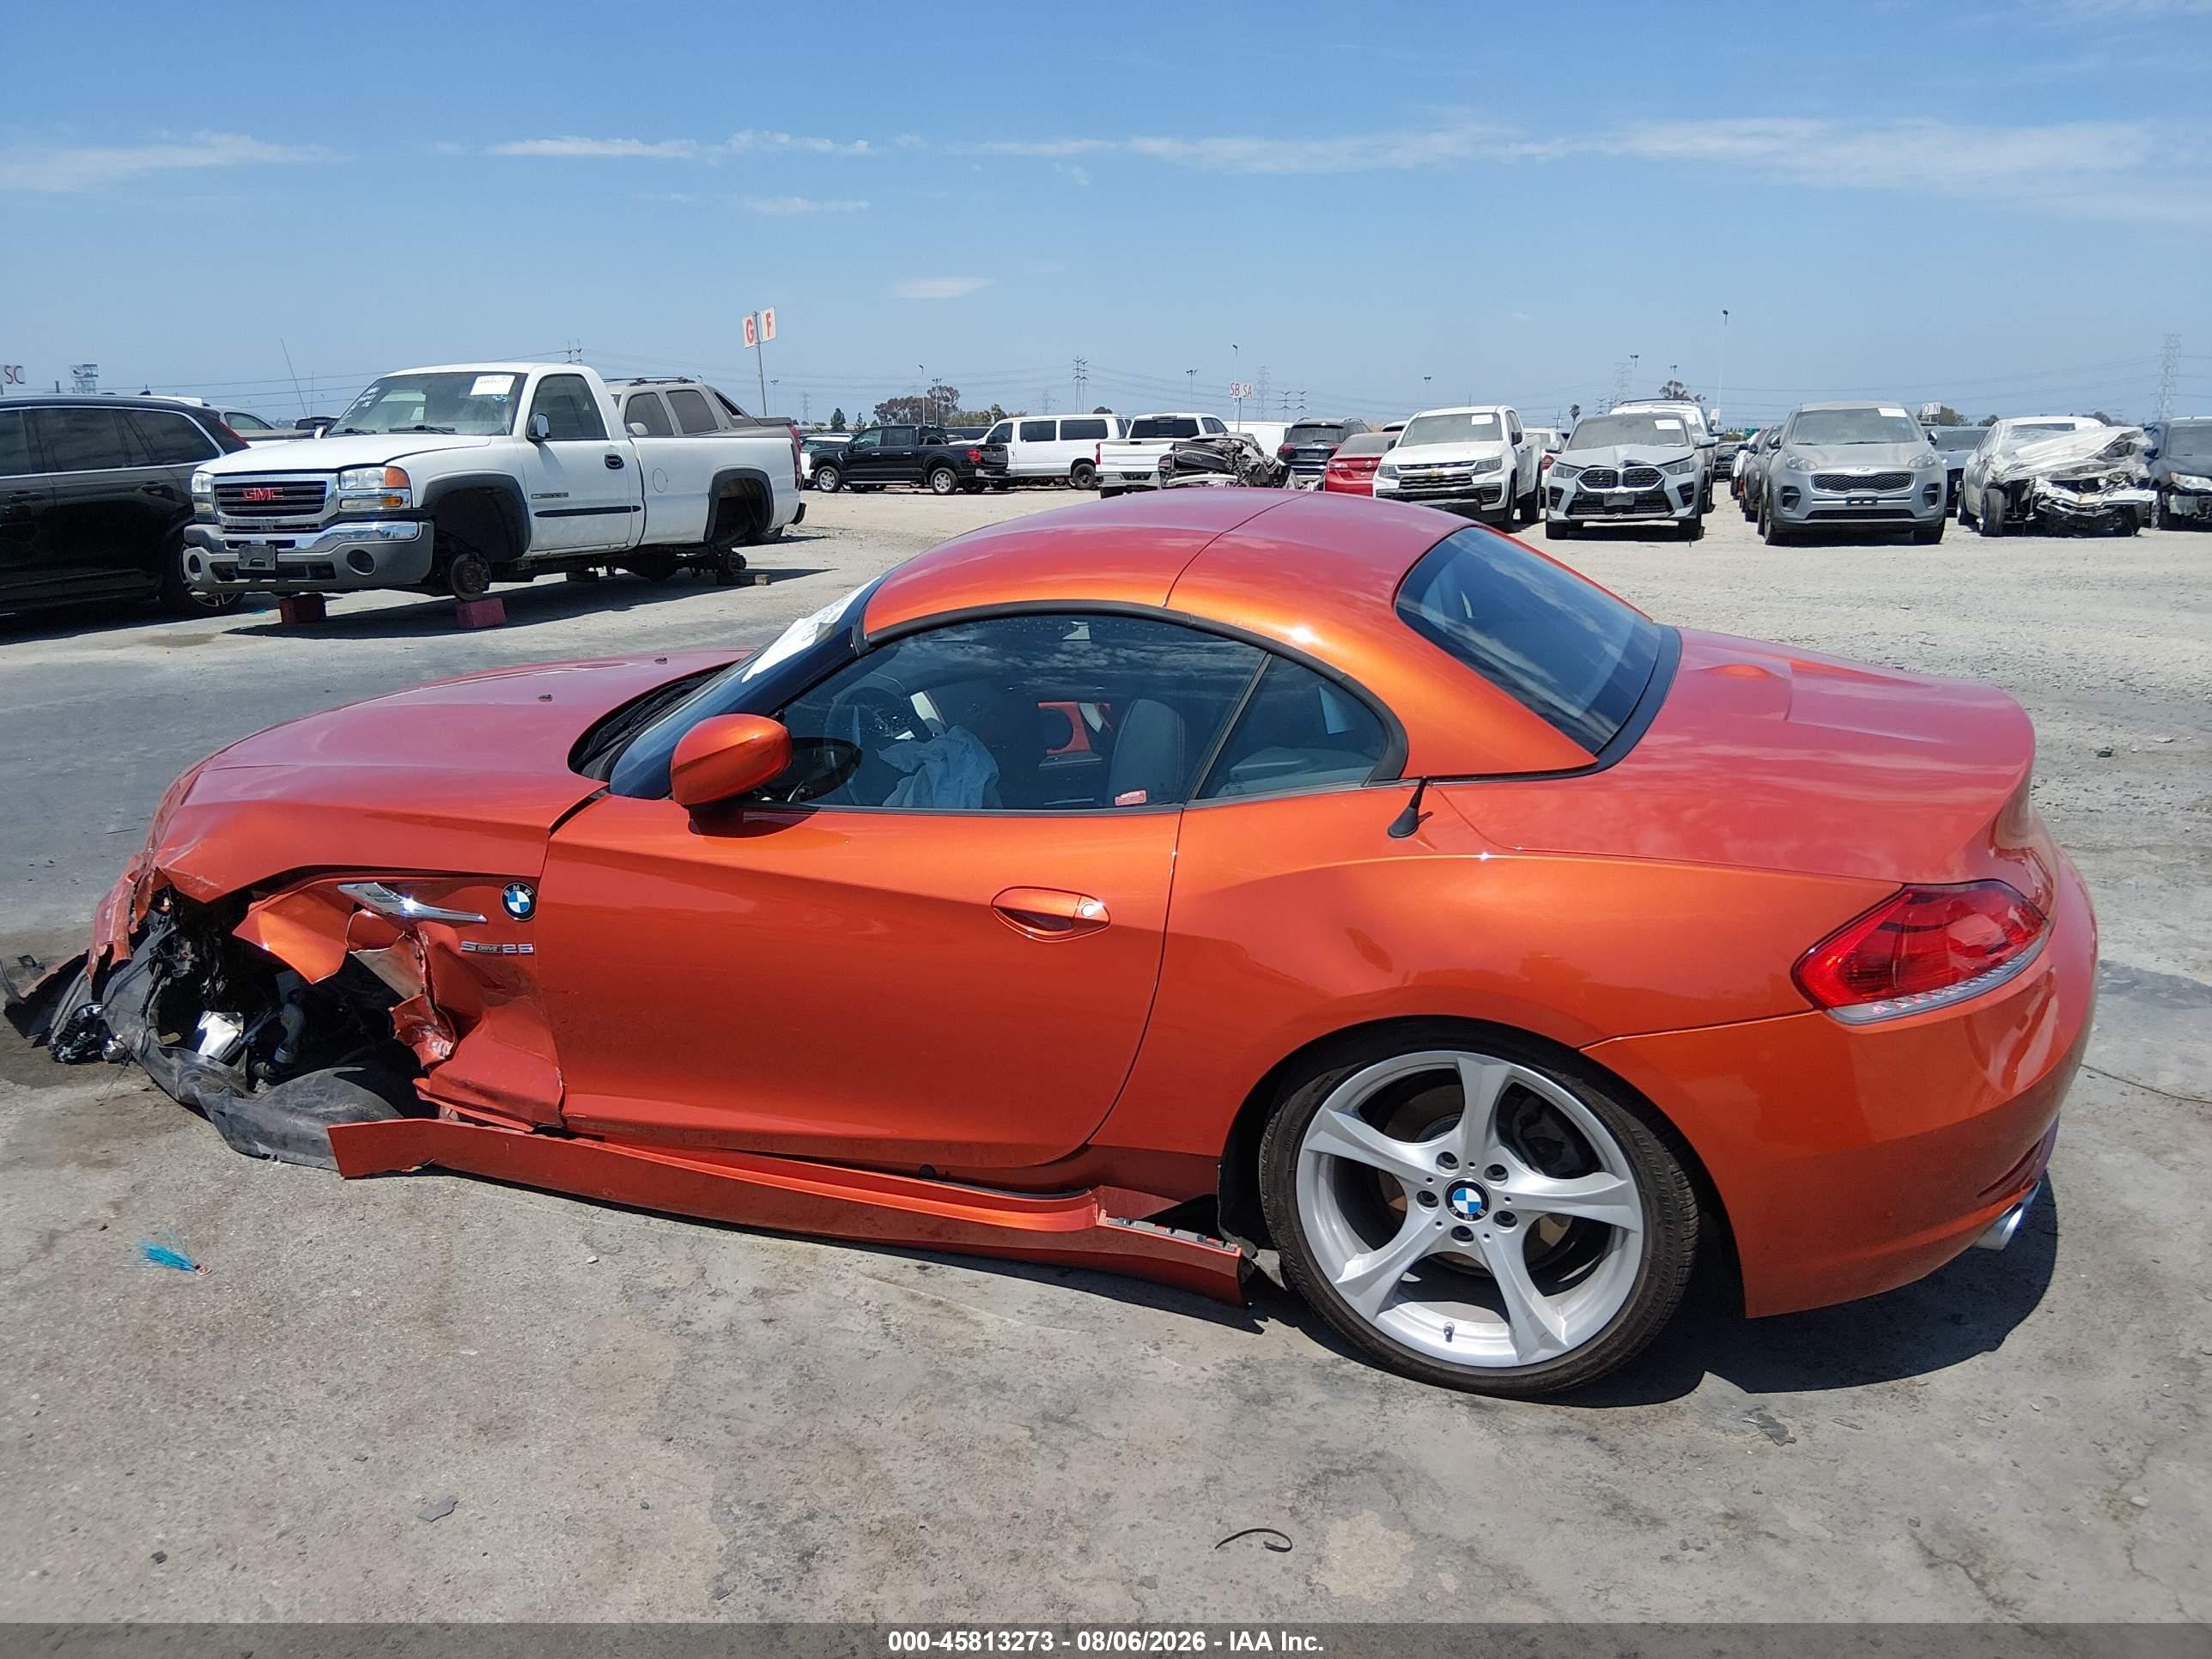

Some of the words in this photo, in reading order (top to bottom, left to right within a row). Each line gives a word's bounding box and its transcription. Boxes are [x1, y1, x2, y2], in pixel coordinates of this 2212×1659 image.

[745, 318, 755, 344] G
[765, 311, 772, 337] F
[3, 365, 25, 385] SC
[1230, 382, 1240, 397] SB
[1243, 384, 1252, 398] SA
[242, 487, 284, 501] GMC
[503, 884, 533, 897] BMW
